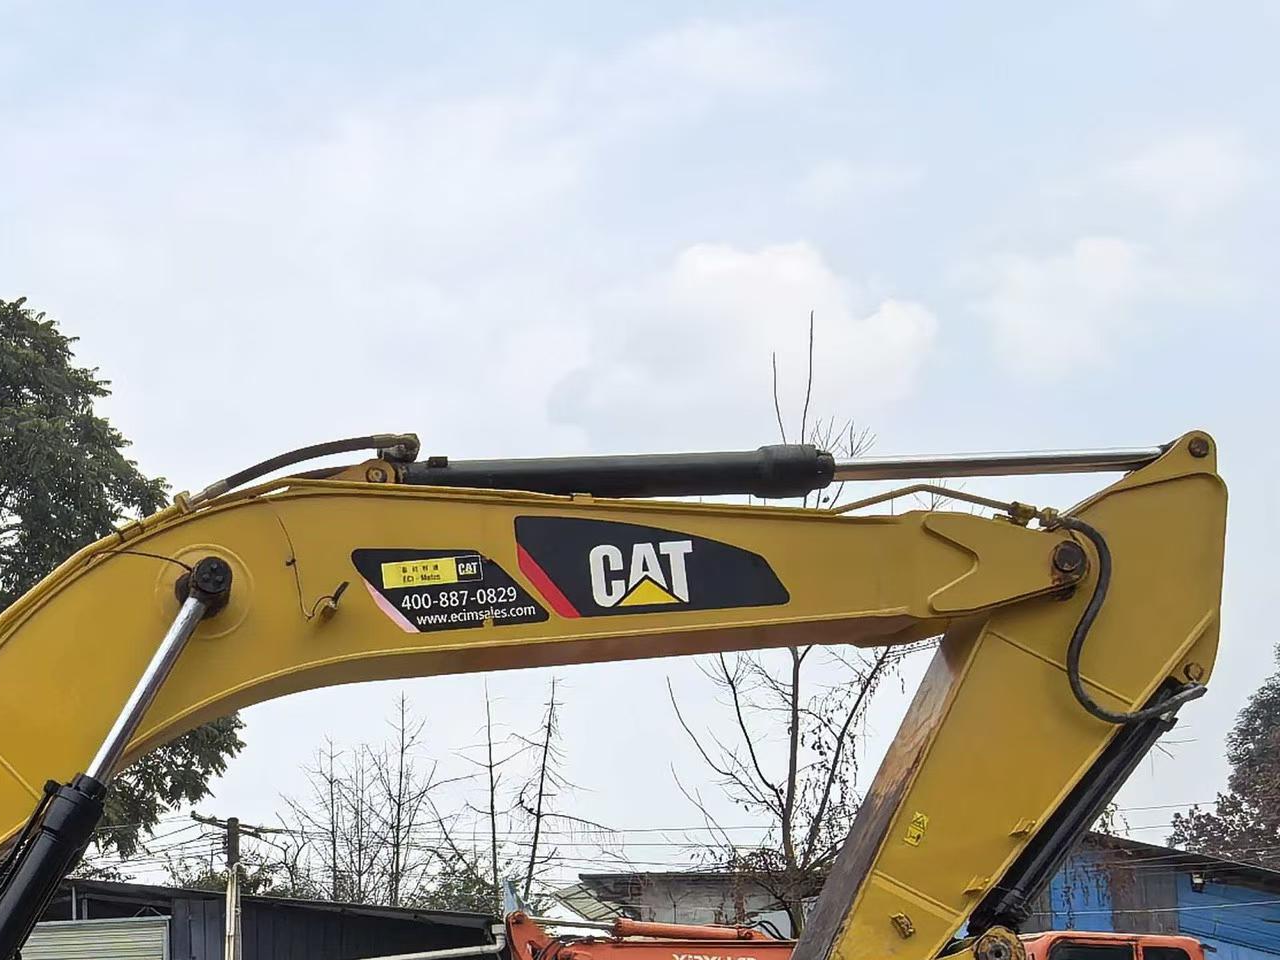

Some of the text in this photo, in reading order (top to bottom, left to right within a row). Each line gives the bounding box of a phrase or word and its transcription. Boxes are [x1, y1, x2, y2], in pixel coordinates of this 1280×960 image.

[458, 562, 478, 576] CAT
[589, 541, 693, 607] CAT
[401, 586, 517, 610] 400-887-0829
[417, 605, 537, 625] www.ecimsales.com
